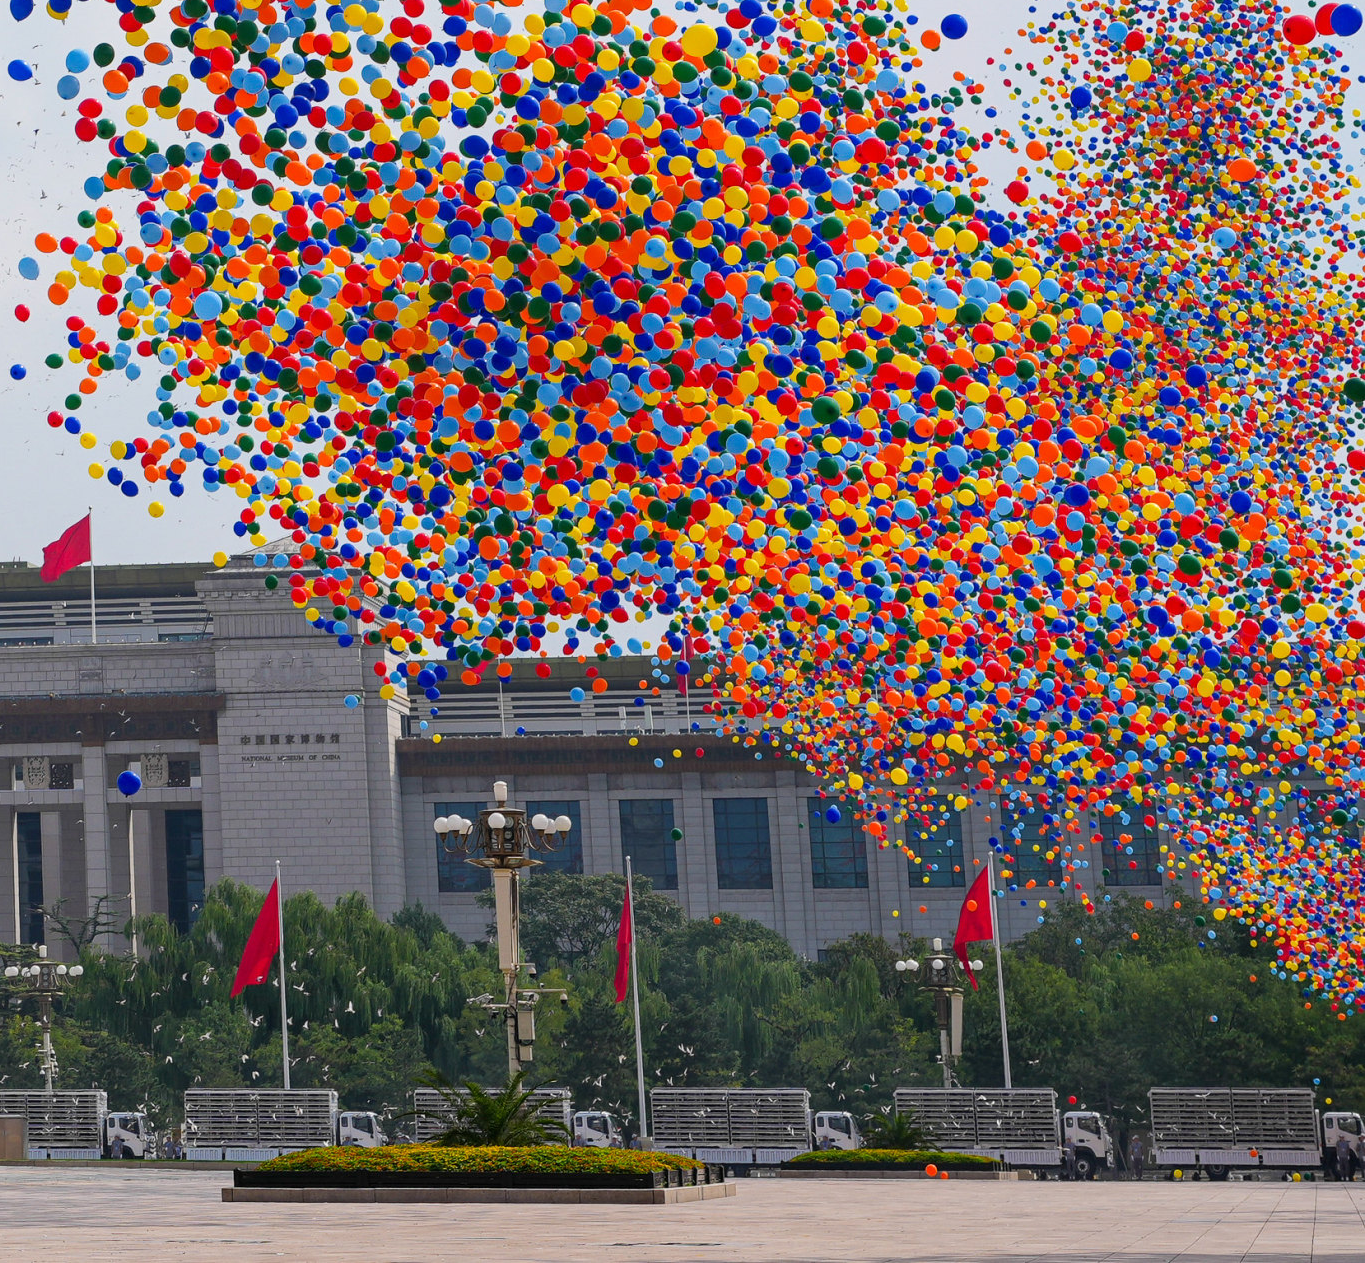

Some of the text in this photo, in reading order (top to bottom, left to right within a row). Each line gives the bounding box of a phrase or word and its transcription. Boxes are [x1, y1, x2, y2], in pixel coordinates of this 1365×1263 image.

[240, 732, 340, 745] 中国国家博物馆
